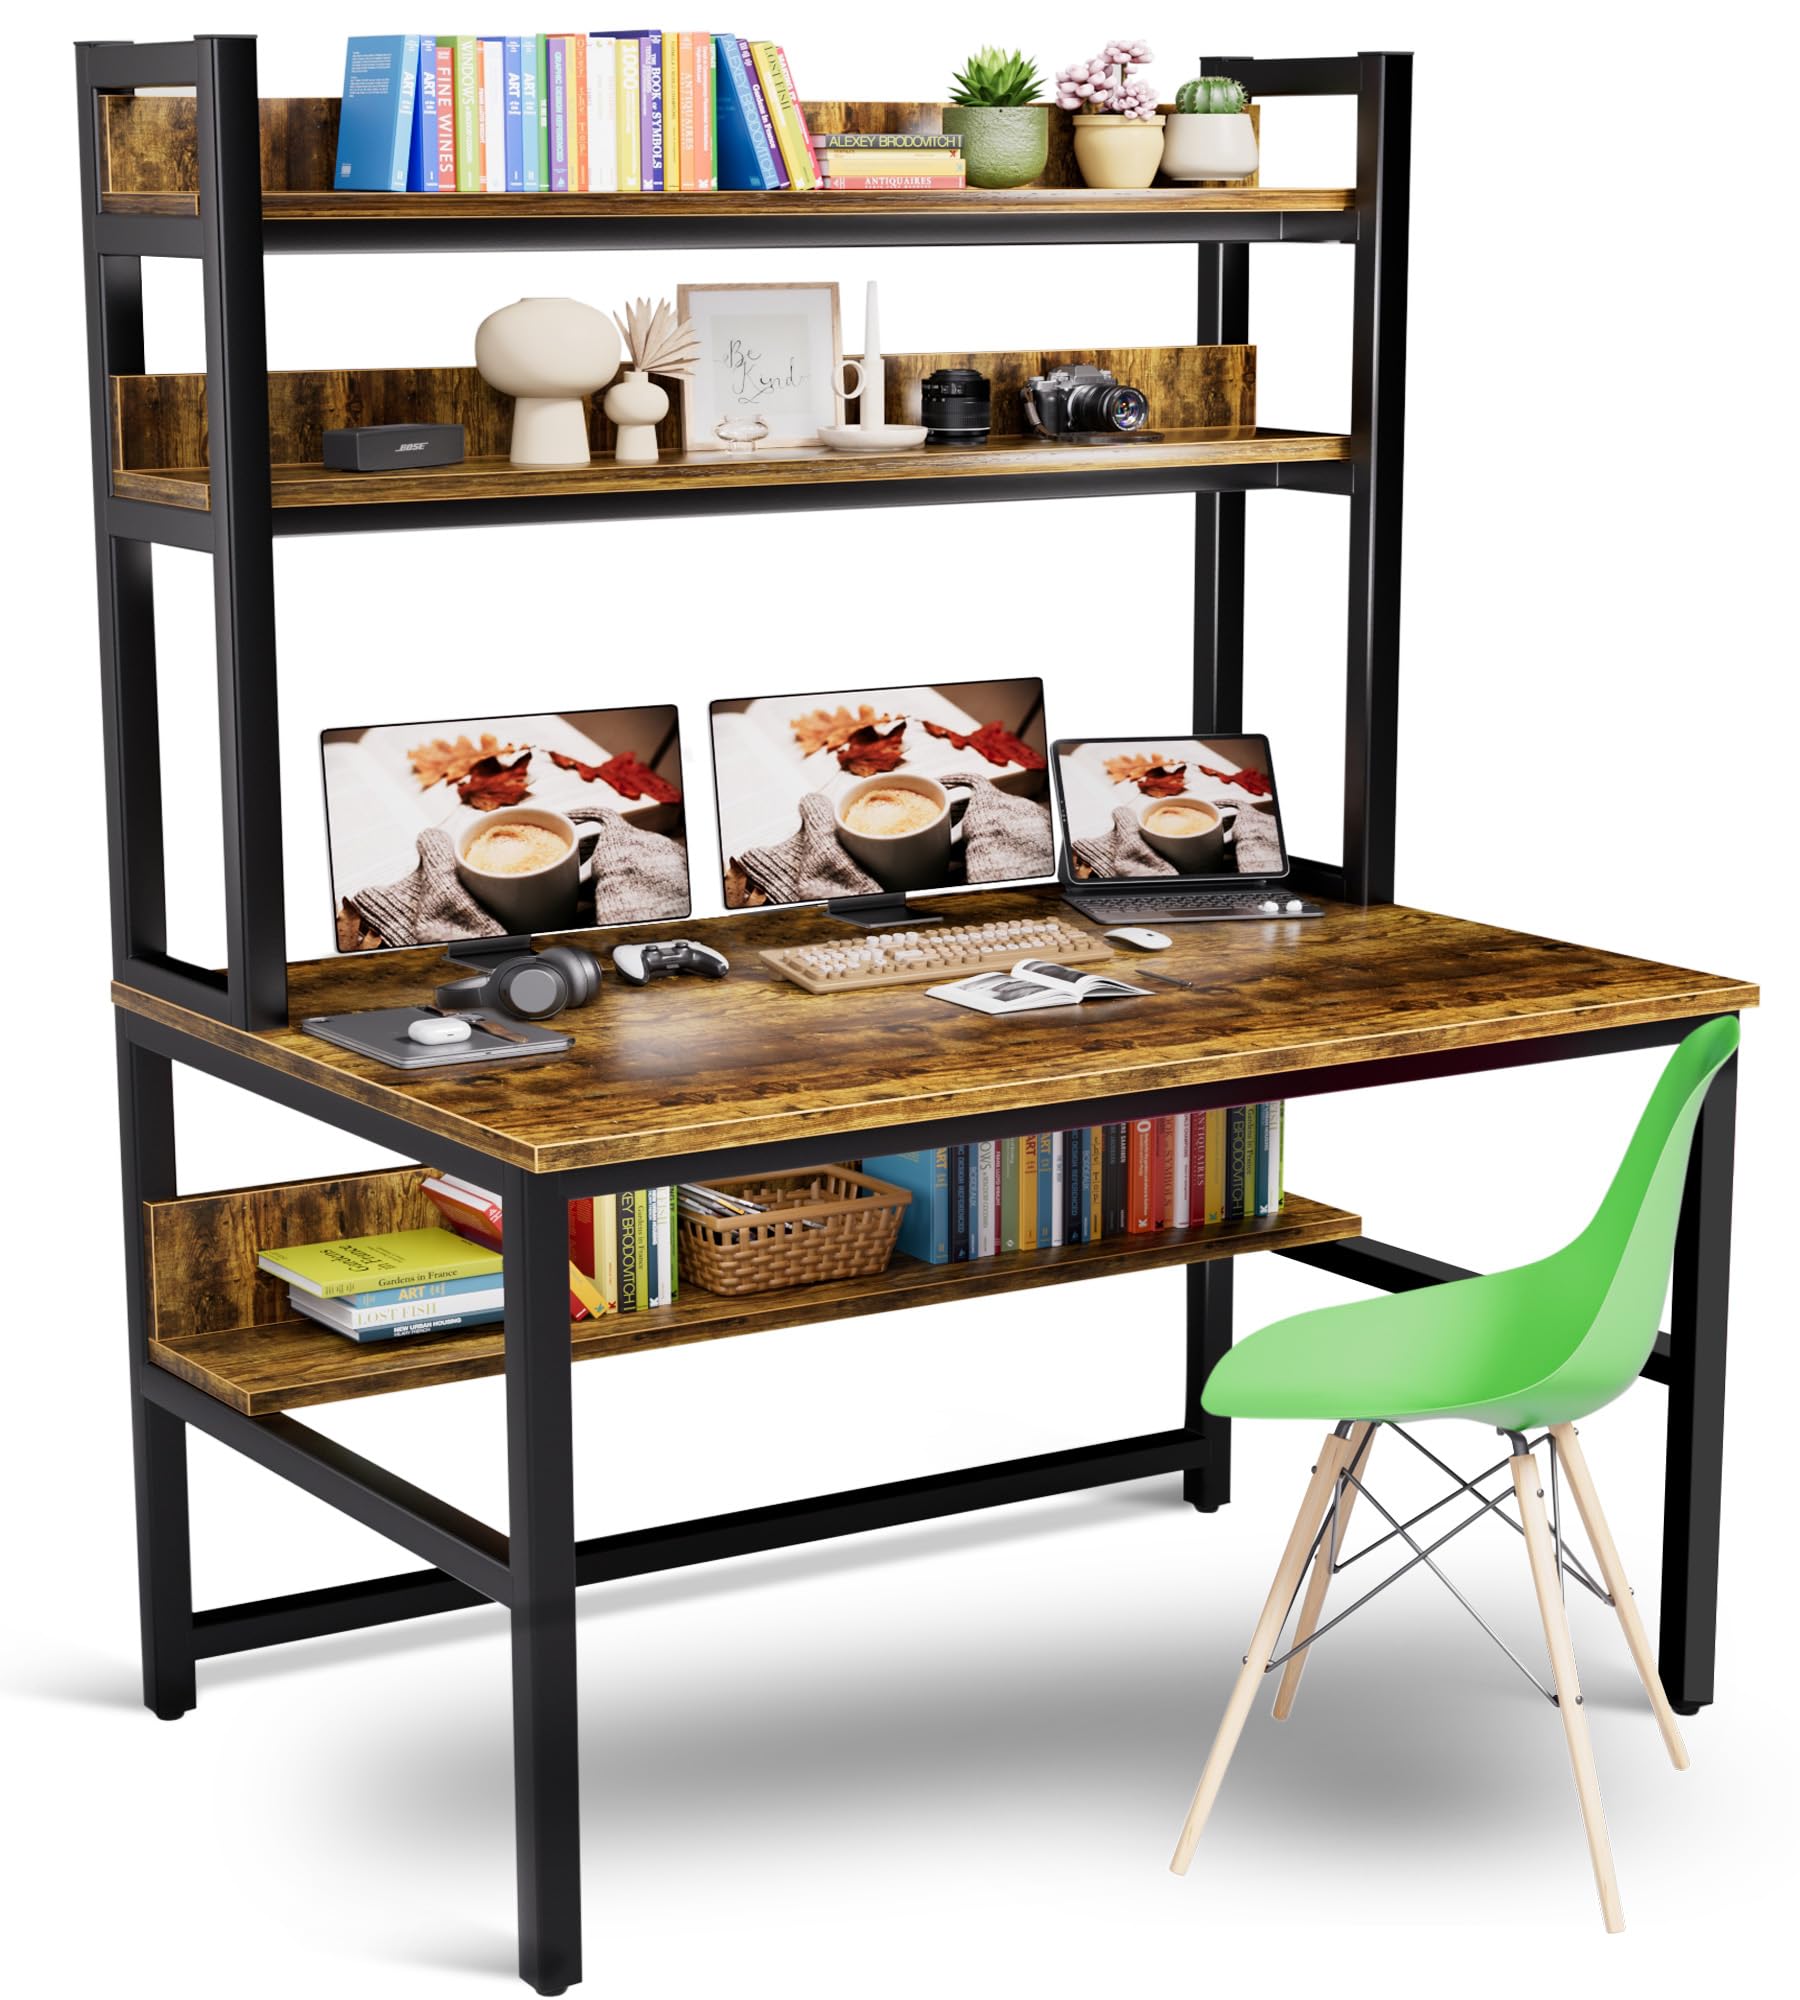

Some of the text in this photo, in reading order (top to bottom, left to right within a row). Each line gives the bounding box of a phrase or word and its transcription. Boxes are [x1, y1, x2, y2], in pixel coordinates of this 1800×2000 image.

[461, 40, 475, 105] WINDOWS
[623, 44, 639, 90] 1000
[764, 45, 783, 81] LOST
[775, 81, 792, 111] FISH
[402, 71, 415, 97] ART
[423, 71, 436, 97] ART
[508, 72, 520, 98] ART
[523, 72, 535, 98] ART
[652, 67, 661, 100] BOOK
[437, 66, 453, 173] FINE WINES
[683, 72, 693, 151] ANTIQUAIRES
[723, 37, 775, 178] ALEXEY BRODOVITCH
[752, 83, 777, 149] Gardens in France
[652, 112, 662, 169] SYMBOLS
[828, 135, 952, 148] ALEXEY BRODOVITCH
[864, 176, 932, 187] ANTIQUAIRES
[723, 339, 762, 368] Be
[395, 442, 429, 452] BOSE
[1025, 1135, 1036, 1157] ART
[1232, 1121, 1244, 1209] BRODOVITCH
[622, 1217, 635, 1304] BRODOVITCH
[378, 1269, 458, 1287] Gardens in France
[398, 1285, 426, 1301] ART
[356, 1303, 438, 1326] LOST FISH
[409, 1322, 432, 1330] URBAN
[433, 1317, 462, 1327] HOUSING
